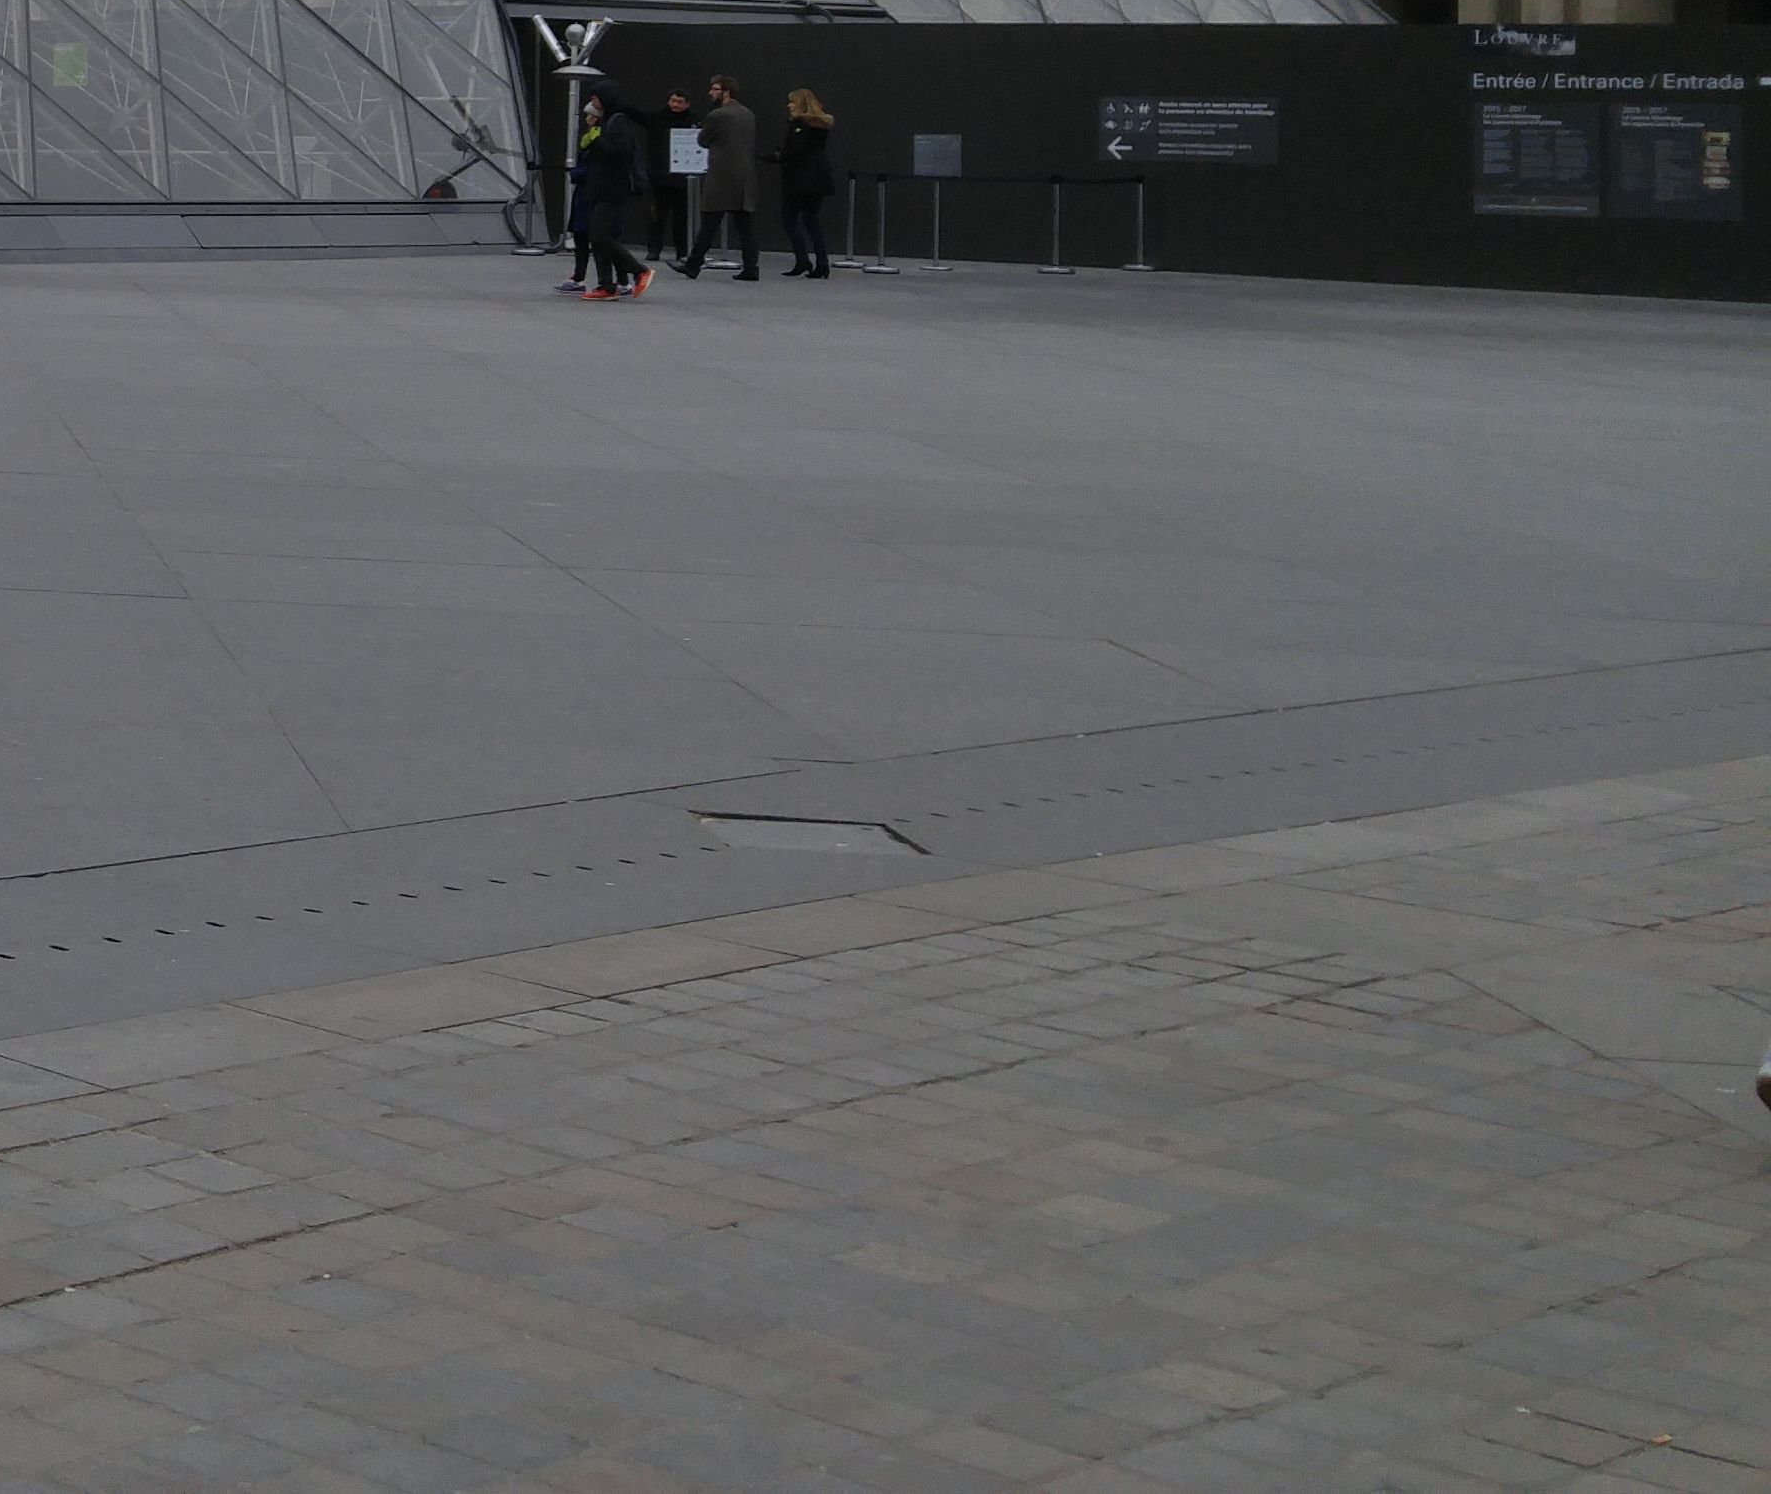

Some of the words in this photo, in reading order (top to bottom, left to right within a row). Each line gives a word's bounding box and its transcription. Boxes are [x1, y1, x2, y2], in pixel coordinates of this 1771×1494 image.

[1473, 72, 1537, 90] Entrée
[1542, 73, 1550, 90] /
[1554, 72, 1645, 90] Entrance
[1650, 73, 1658, 90] /
[1663, 72, 1745, 90] Entrada
